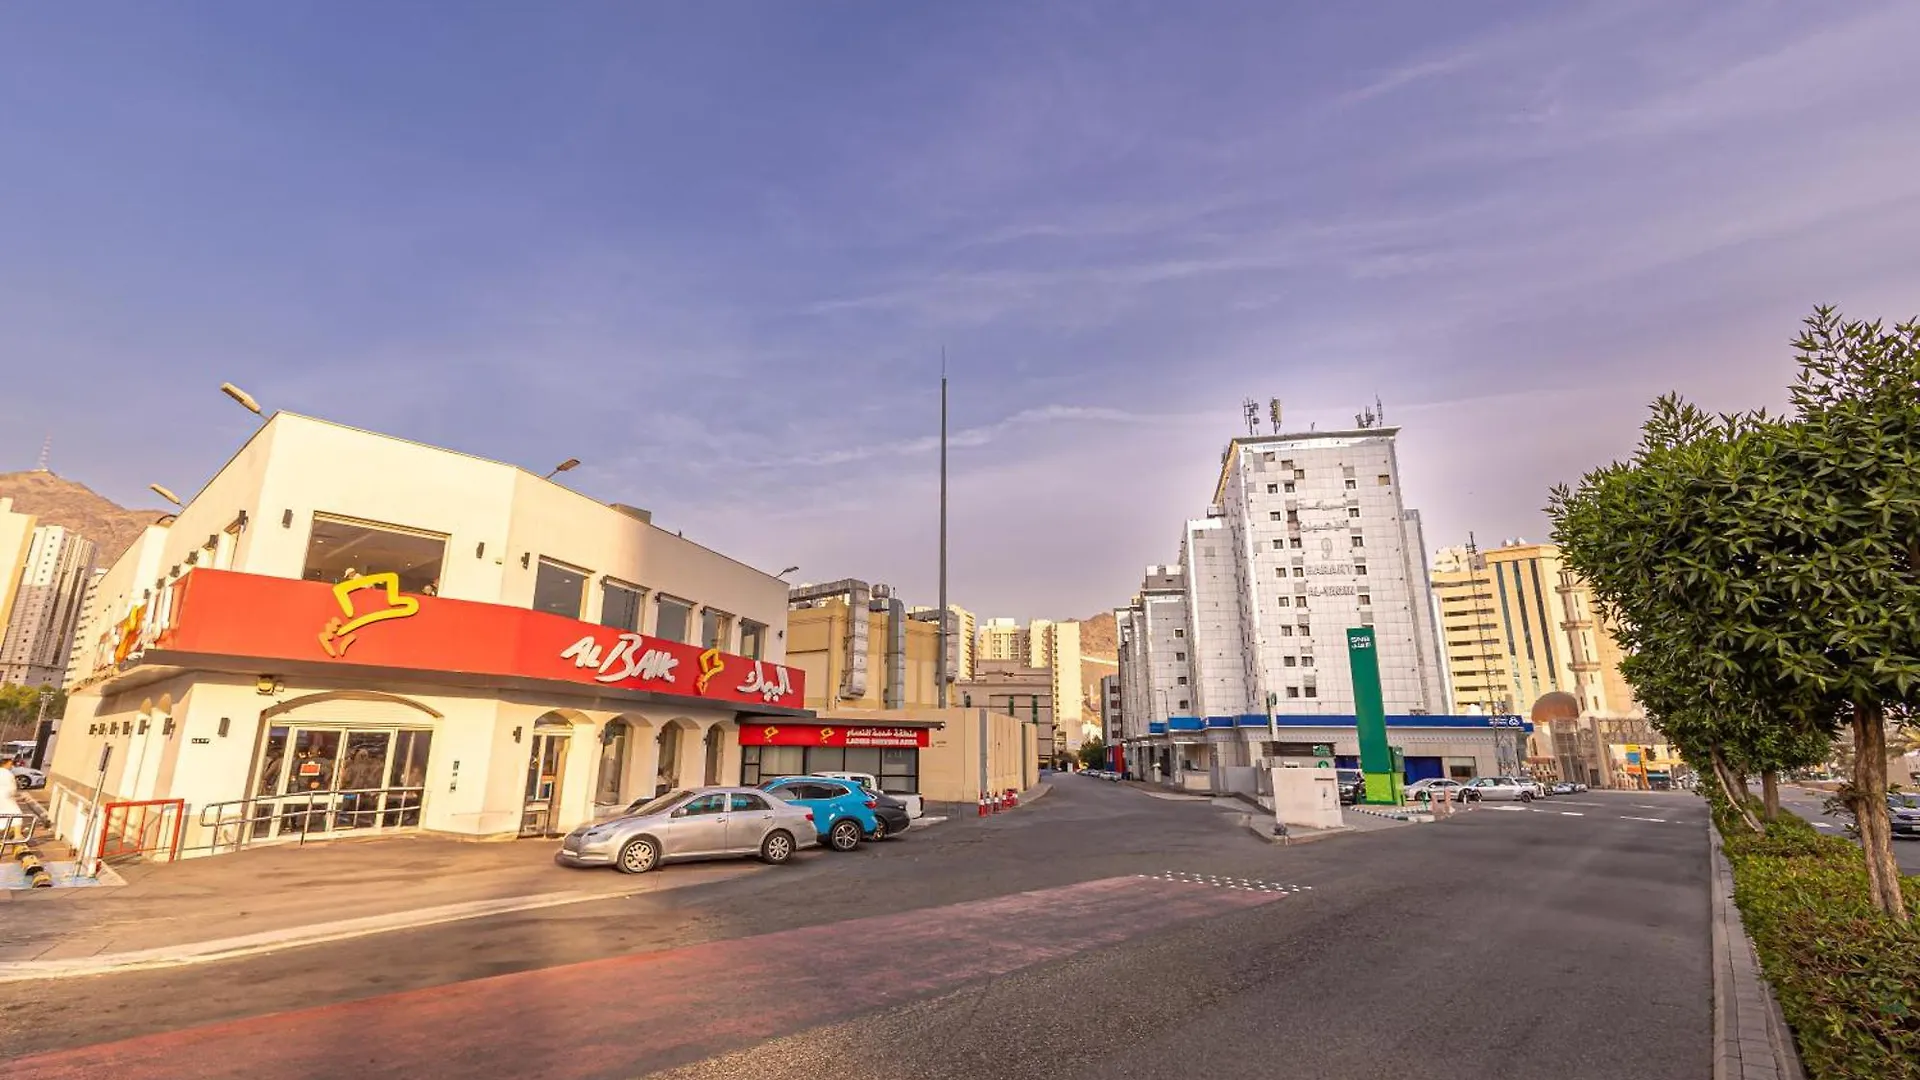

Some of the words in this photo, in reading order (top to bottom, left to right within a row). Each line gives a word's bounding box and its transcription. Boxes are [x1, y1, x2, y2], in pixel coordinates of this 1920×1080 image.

[737, 660, 793, 702] البيك
[845, 737, 870, 745] LADIES
[900, 738, 917, 746] AREA
